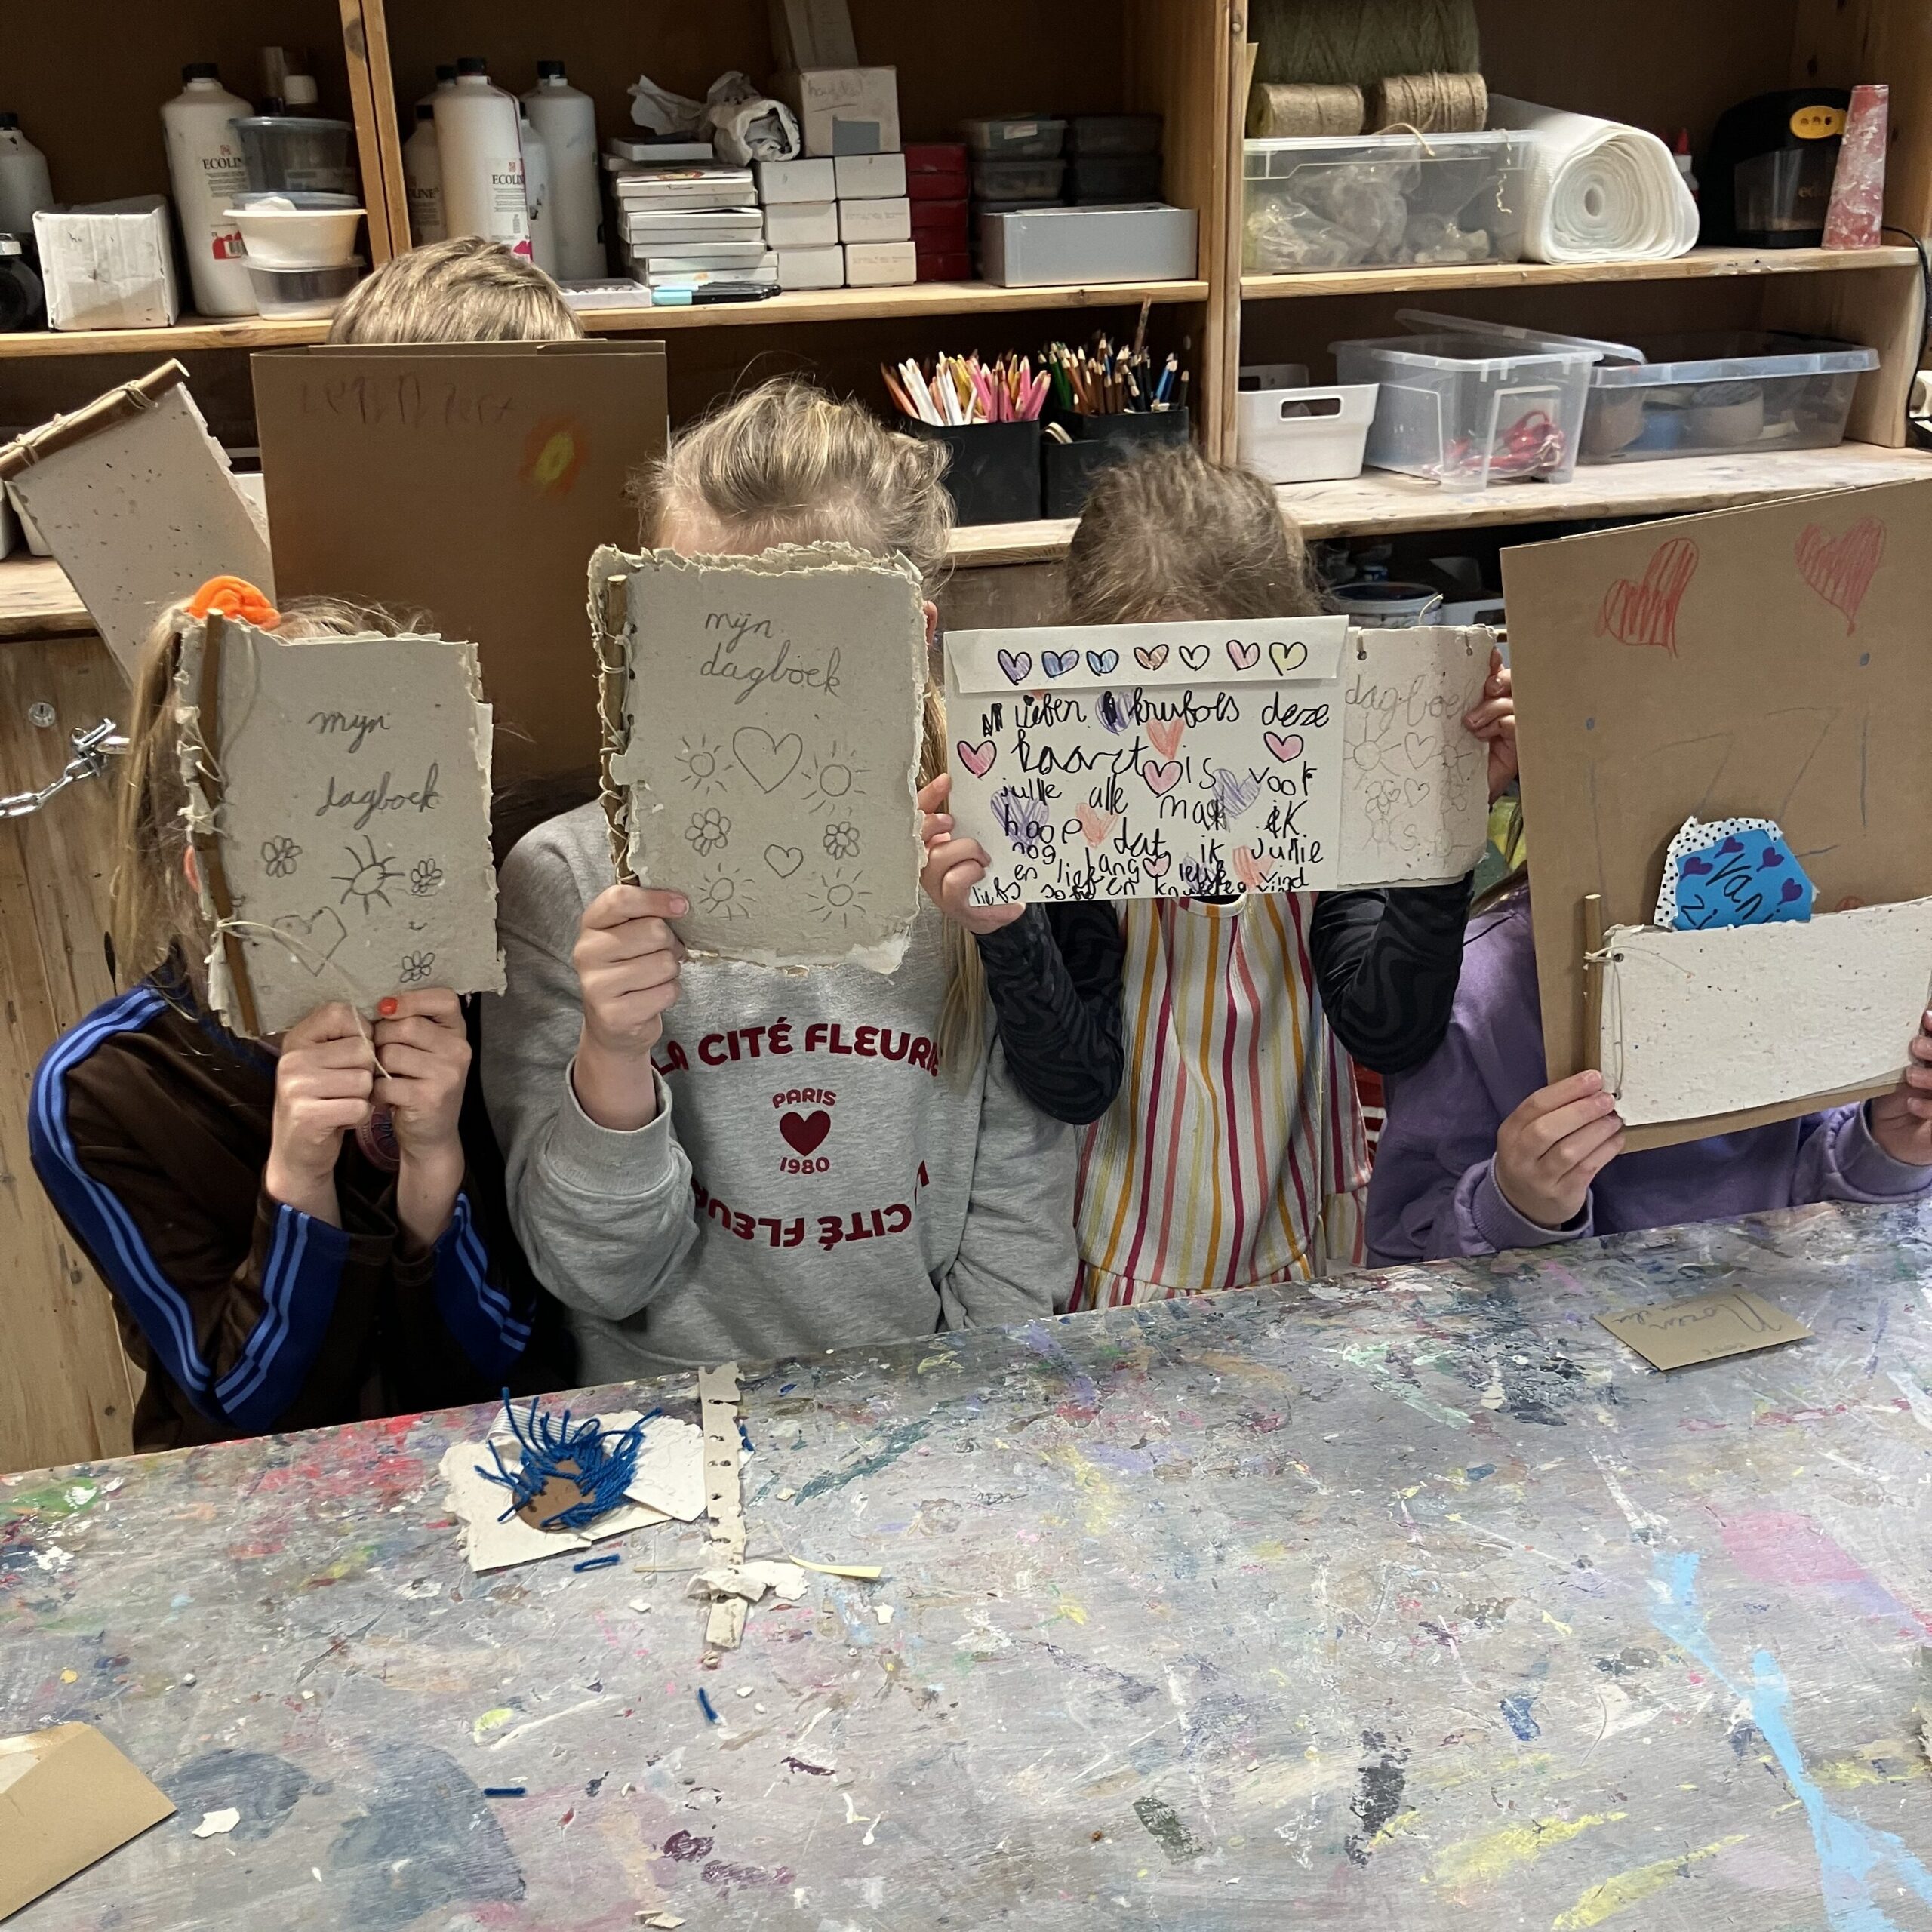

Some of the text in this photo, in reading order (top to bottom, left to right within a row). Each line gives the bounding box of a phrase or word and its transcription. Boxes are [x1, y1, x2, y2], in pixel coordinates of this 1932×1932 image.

[1261, 691, 1330, 728] deze
[1004, 803, 1084, 844] hoop
[1011, 841, 1057, 866] nog
[651, 1039, 690, 1078] LA
[698, 1016, 794, 1066] CITÉ
[772, 1087, 837, 1109] PARIS
[780, 1155, 831, 1175] 1980
[817, 1203, 912, 1251] CITÉ
